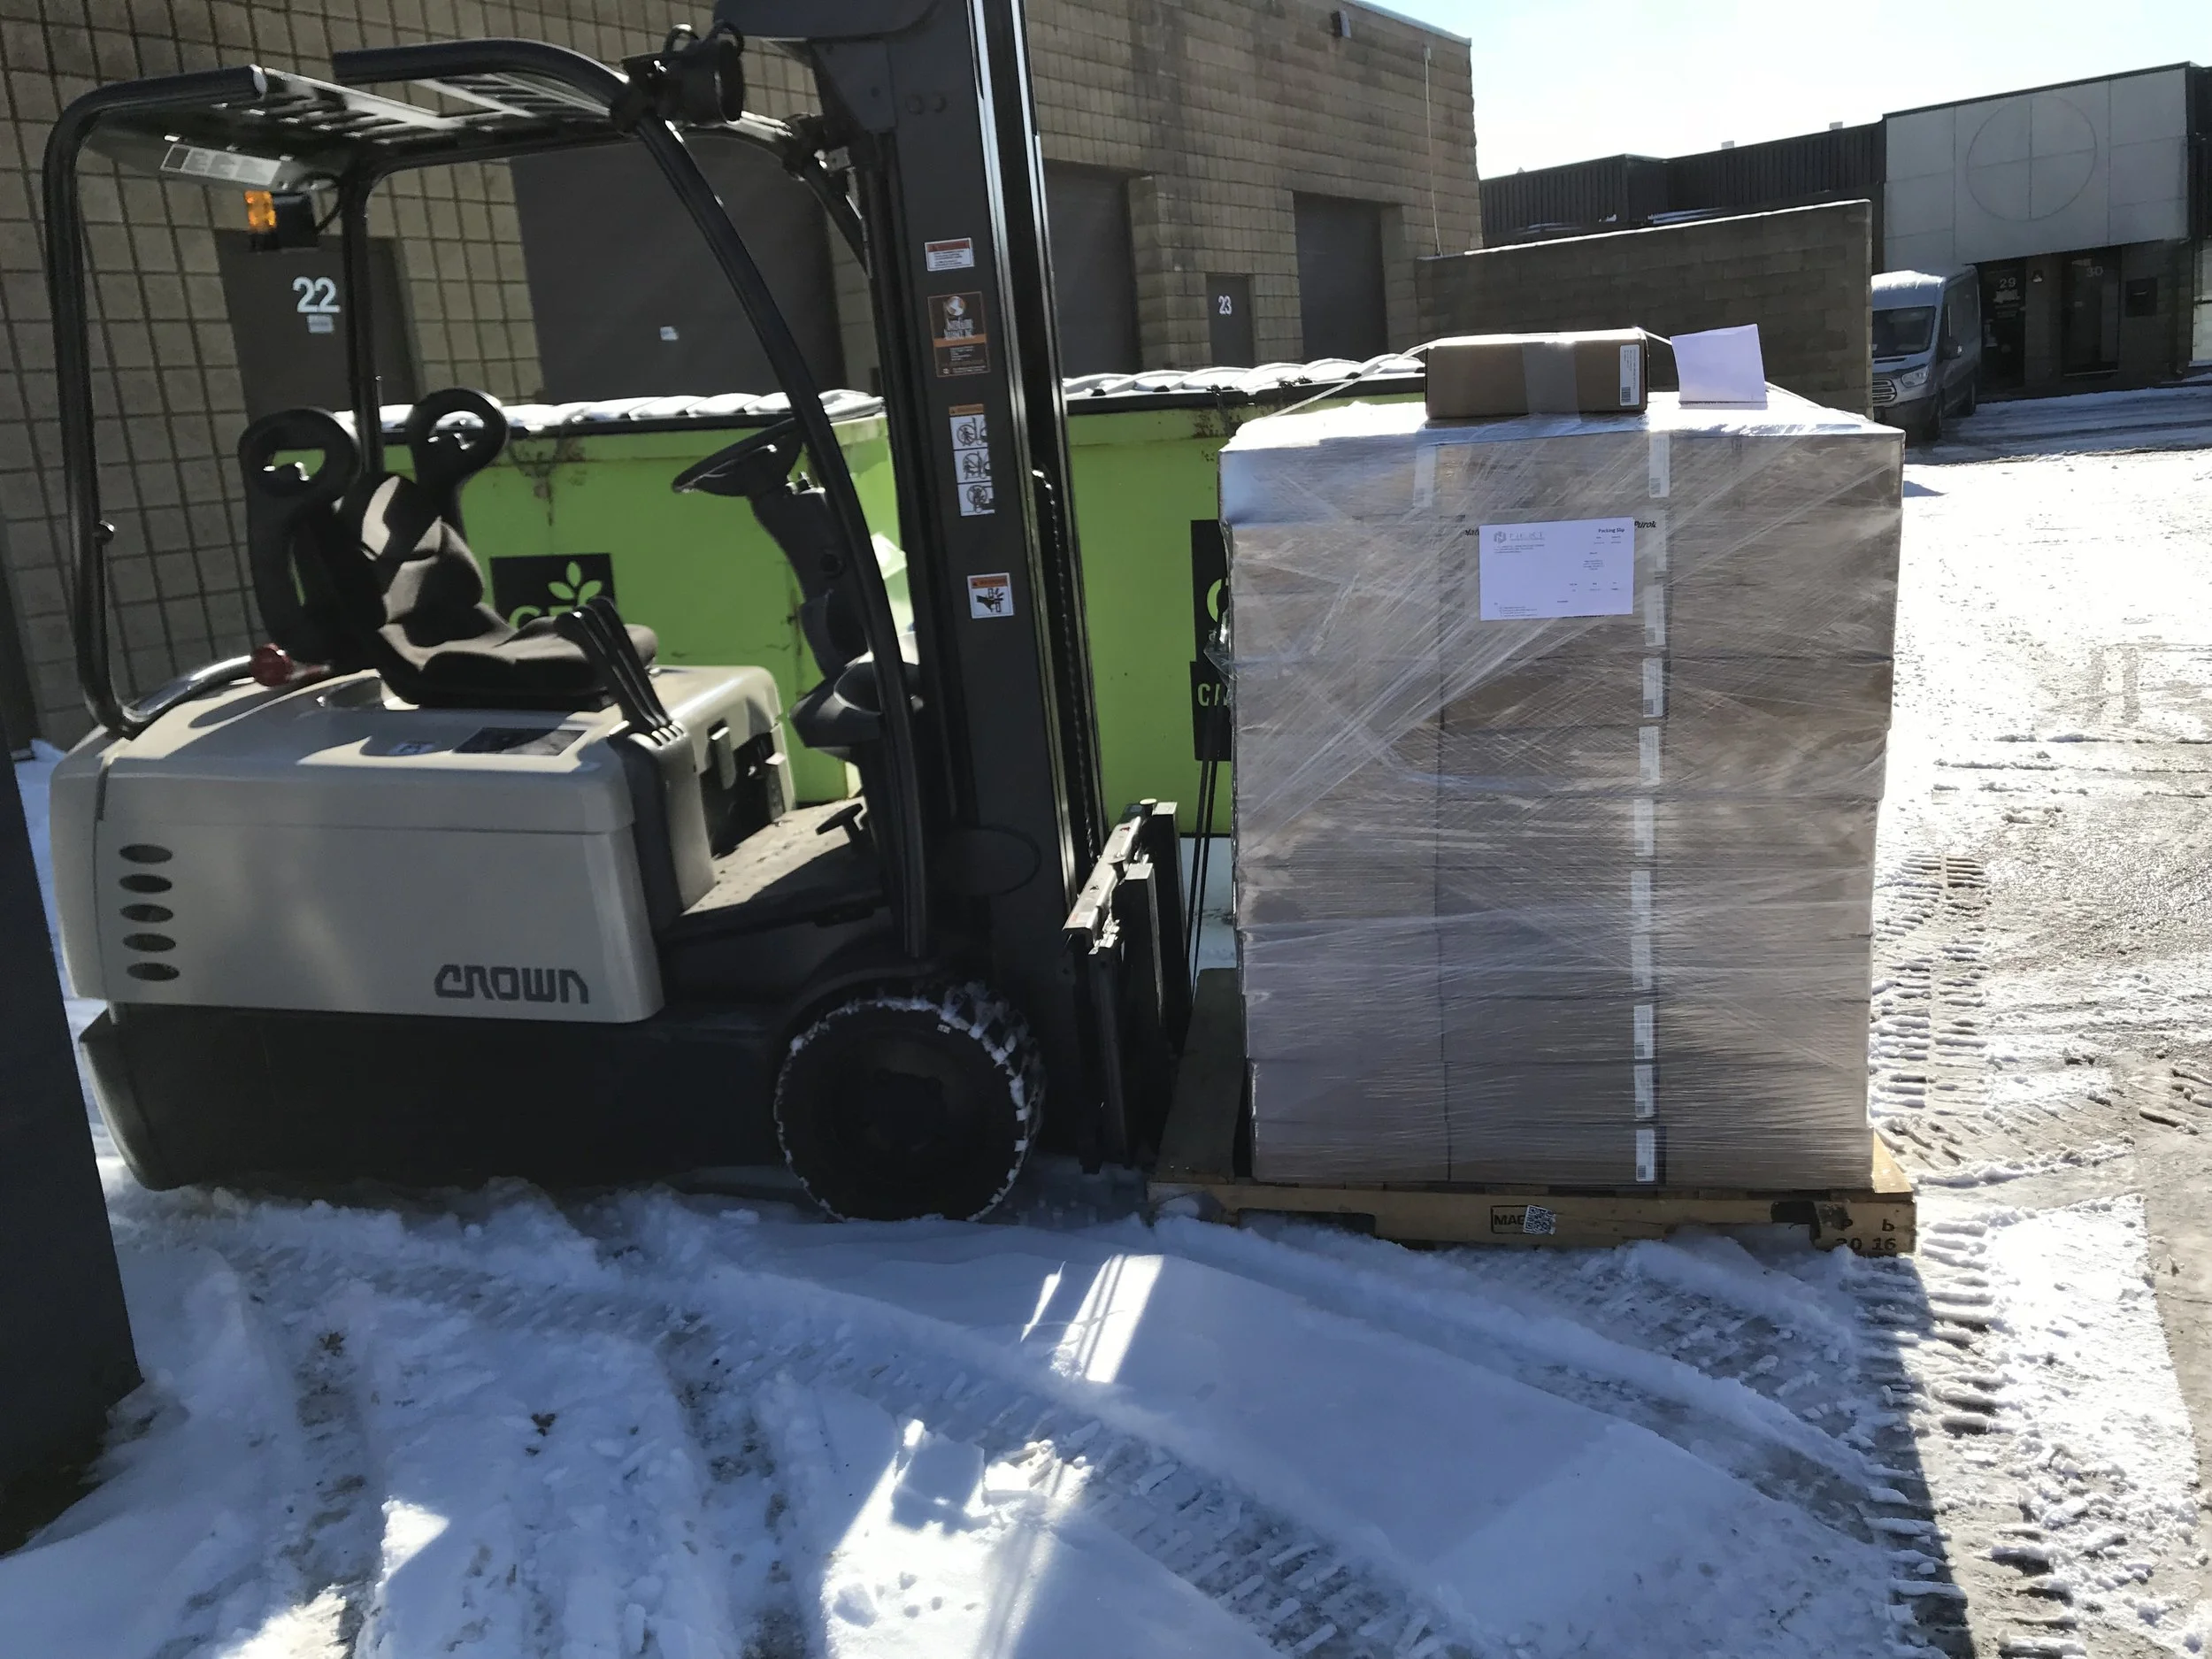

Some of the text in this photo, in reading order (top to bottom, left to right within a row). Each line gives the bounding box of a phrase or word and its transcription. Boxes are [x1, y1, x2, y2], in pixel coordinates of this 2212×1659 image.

[292, 275, 341, 313] 22
[1999, 277, 2016, 288] 29
[1217, 295, 1233, 315] 23
[434, 964, 589, 1004] CROWN
